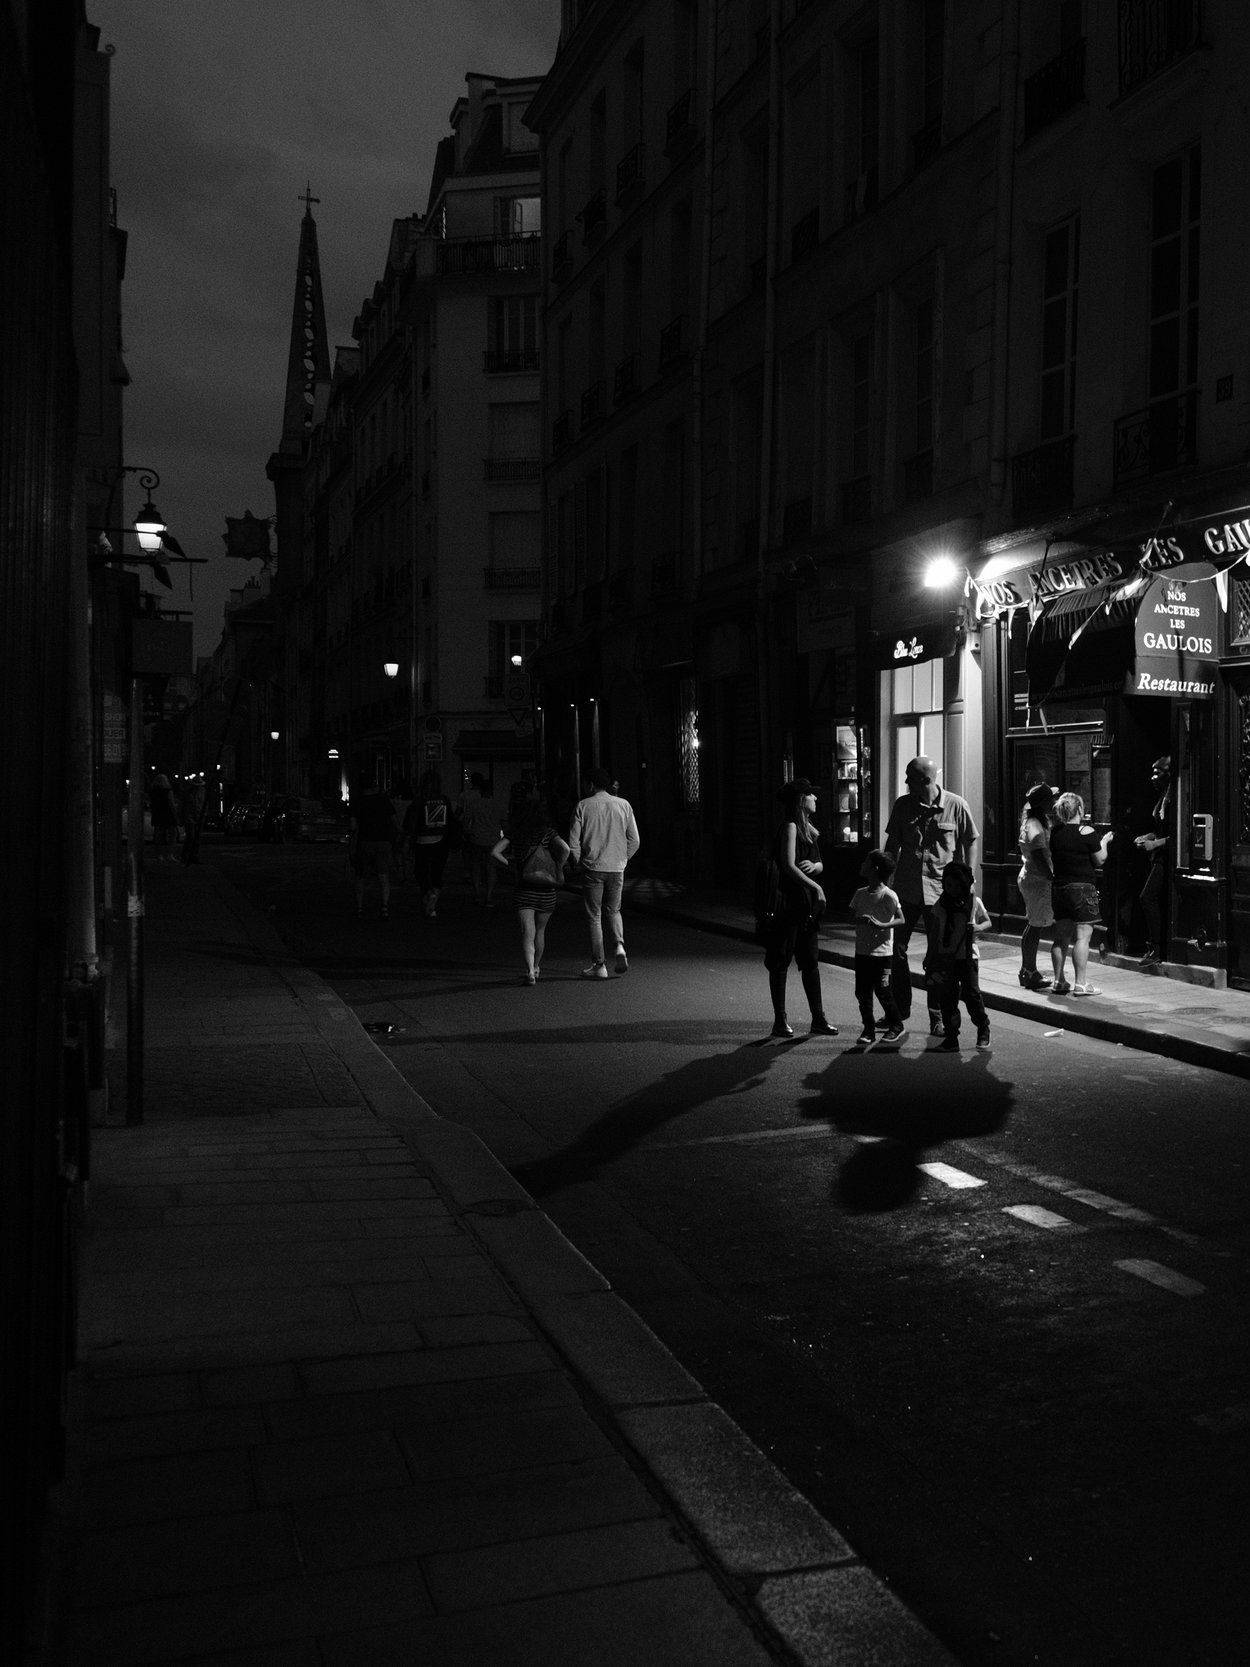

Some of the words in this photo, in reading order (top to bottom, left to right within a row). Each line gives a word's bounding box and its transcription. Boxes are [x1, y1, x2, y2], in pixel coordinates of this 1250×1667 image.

[1028, 552, 1123, 597] ANCETRES
[1167, 590, 1187, 602] NOS
[1154, 603, 1201, 617] ANCETRES
[1169, 618, 1186, 630] LES
[1143, 632, 1213, 654] GAULOIS
[1137, 672, 1216, 695] Restaurant
